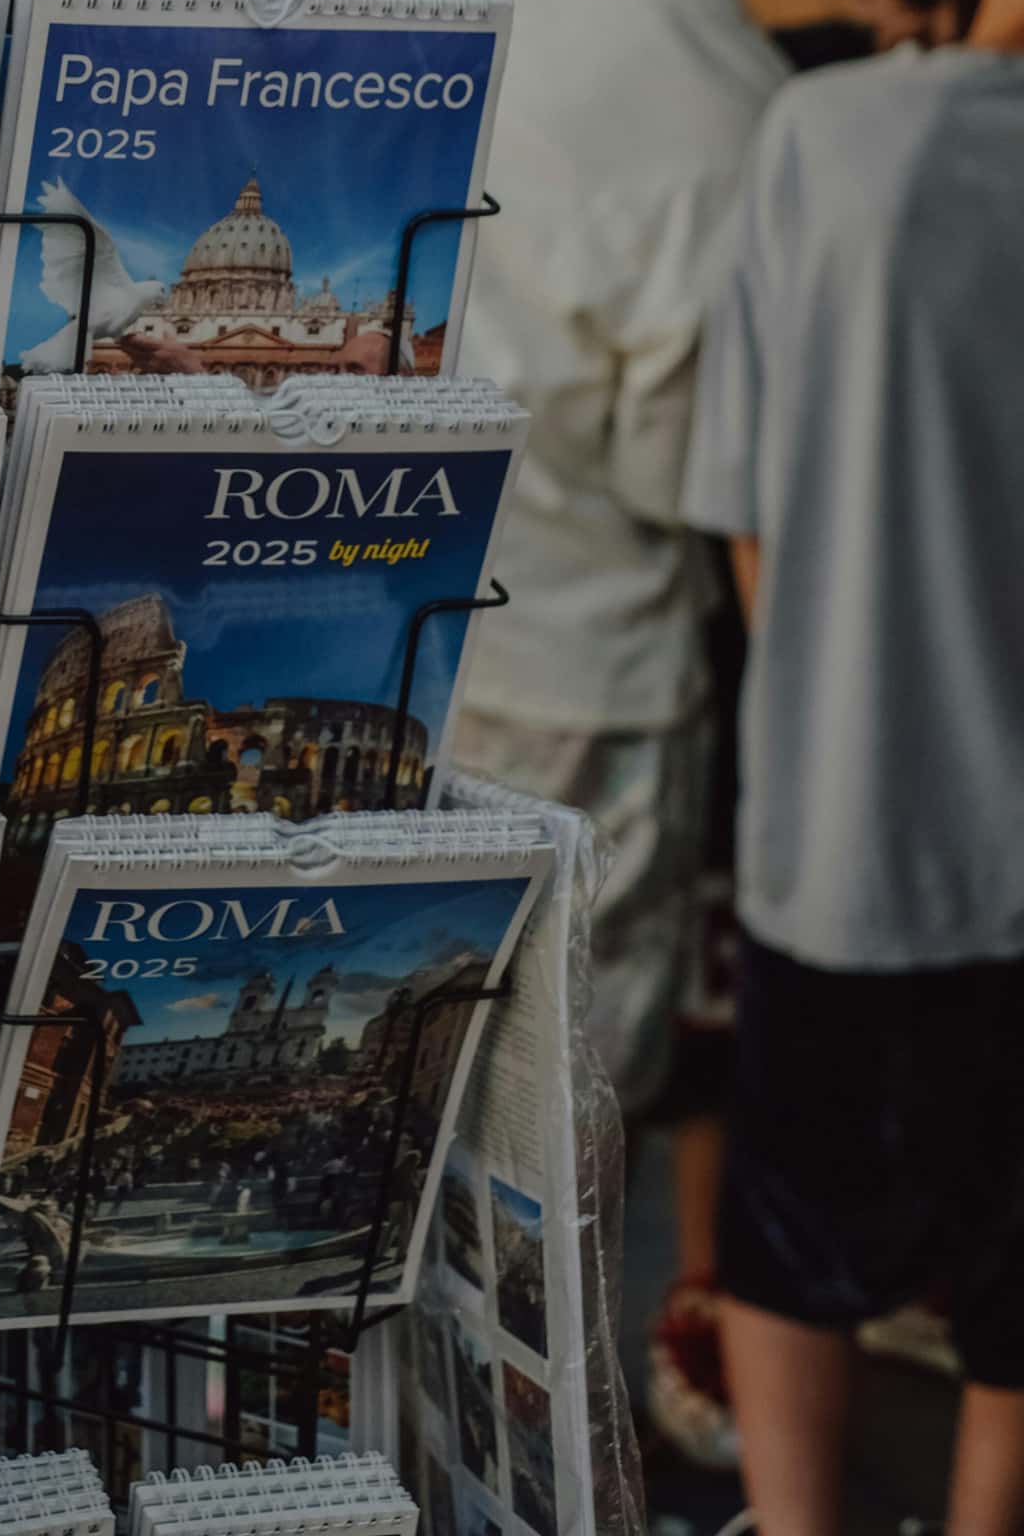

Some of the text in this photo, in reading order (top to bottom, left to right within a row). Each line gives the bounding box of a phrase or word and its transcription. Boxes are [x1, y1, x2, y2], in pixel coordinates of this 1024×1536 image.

[55, 53, 474, 116] Papa Francesco
[48, 128, 157, 160] 2025
[203, 466, 462, 520] ROMA
[202, 537, 431, 567] 2025 by night
[82, 897, 348, 944] ROMA
[81, 956, 199, 982] 2025
